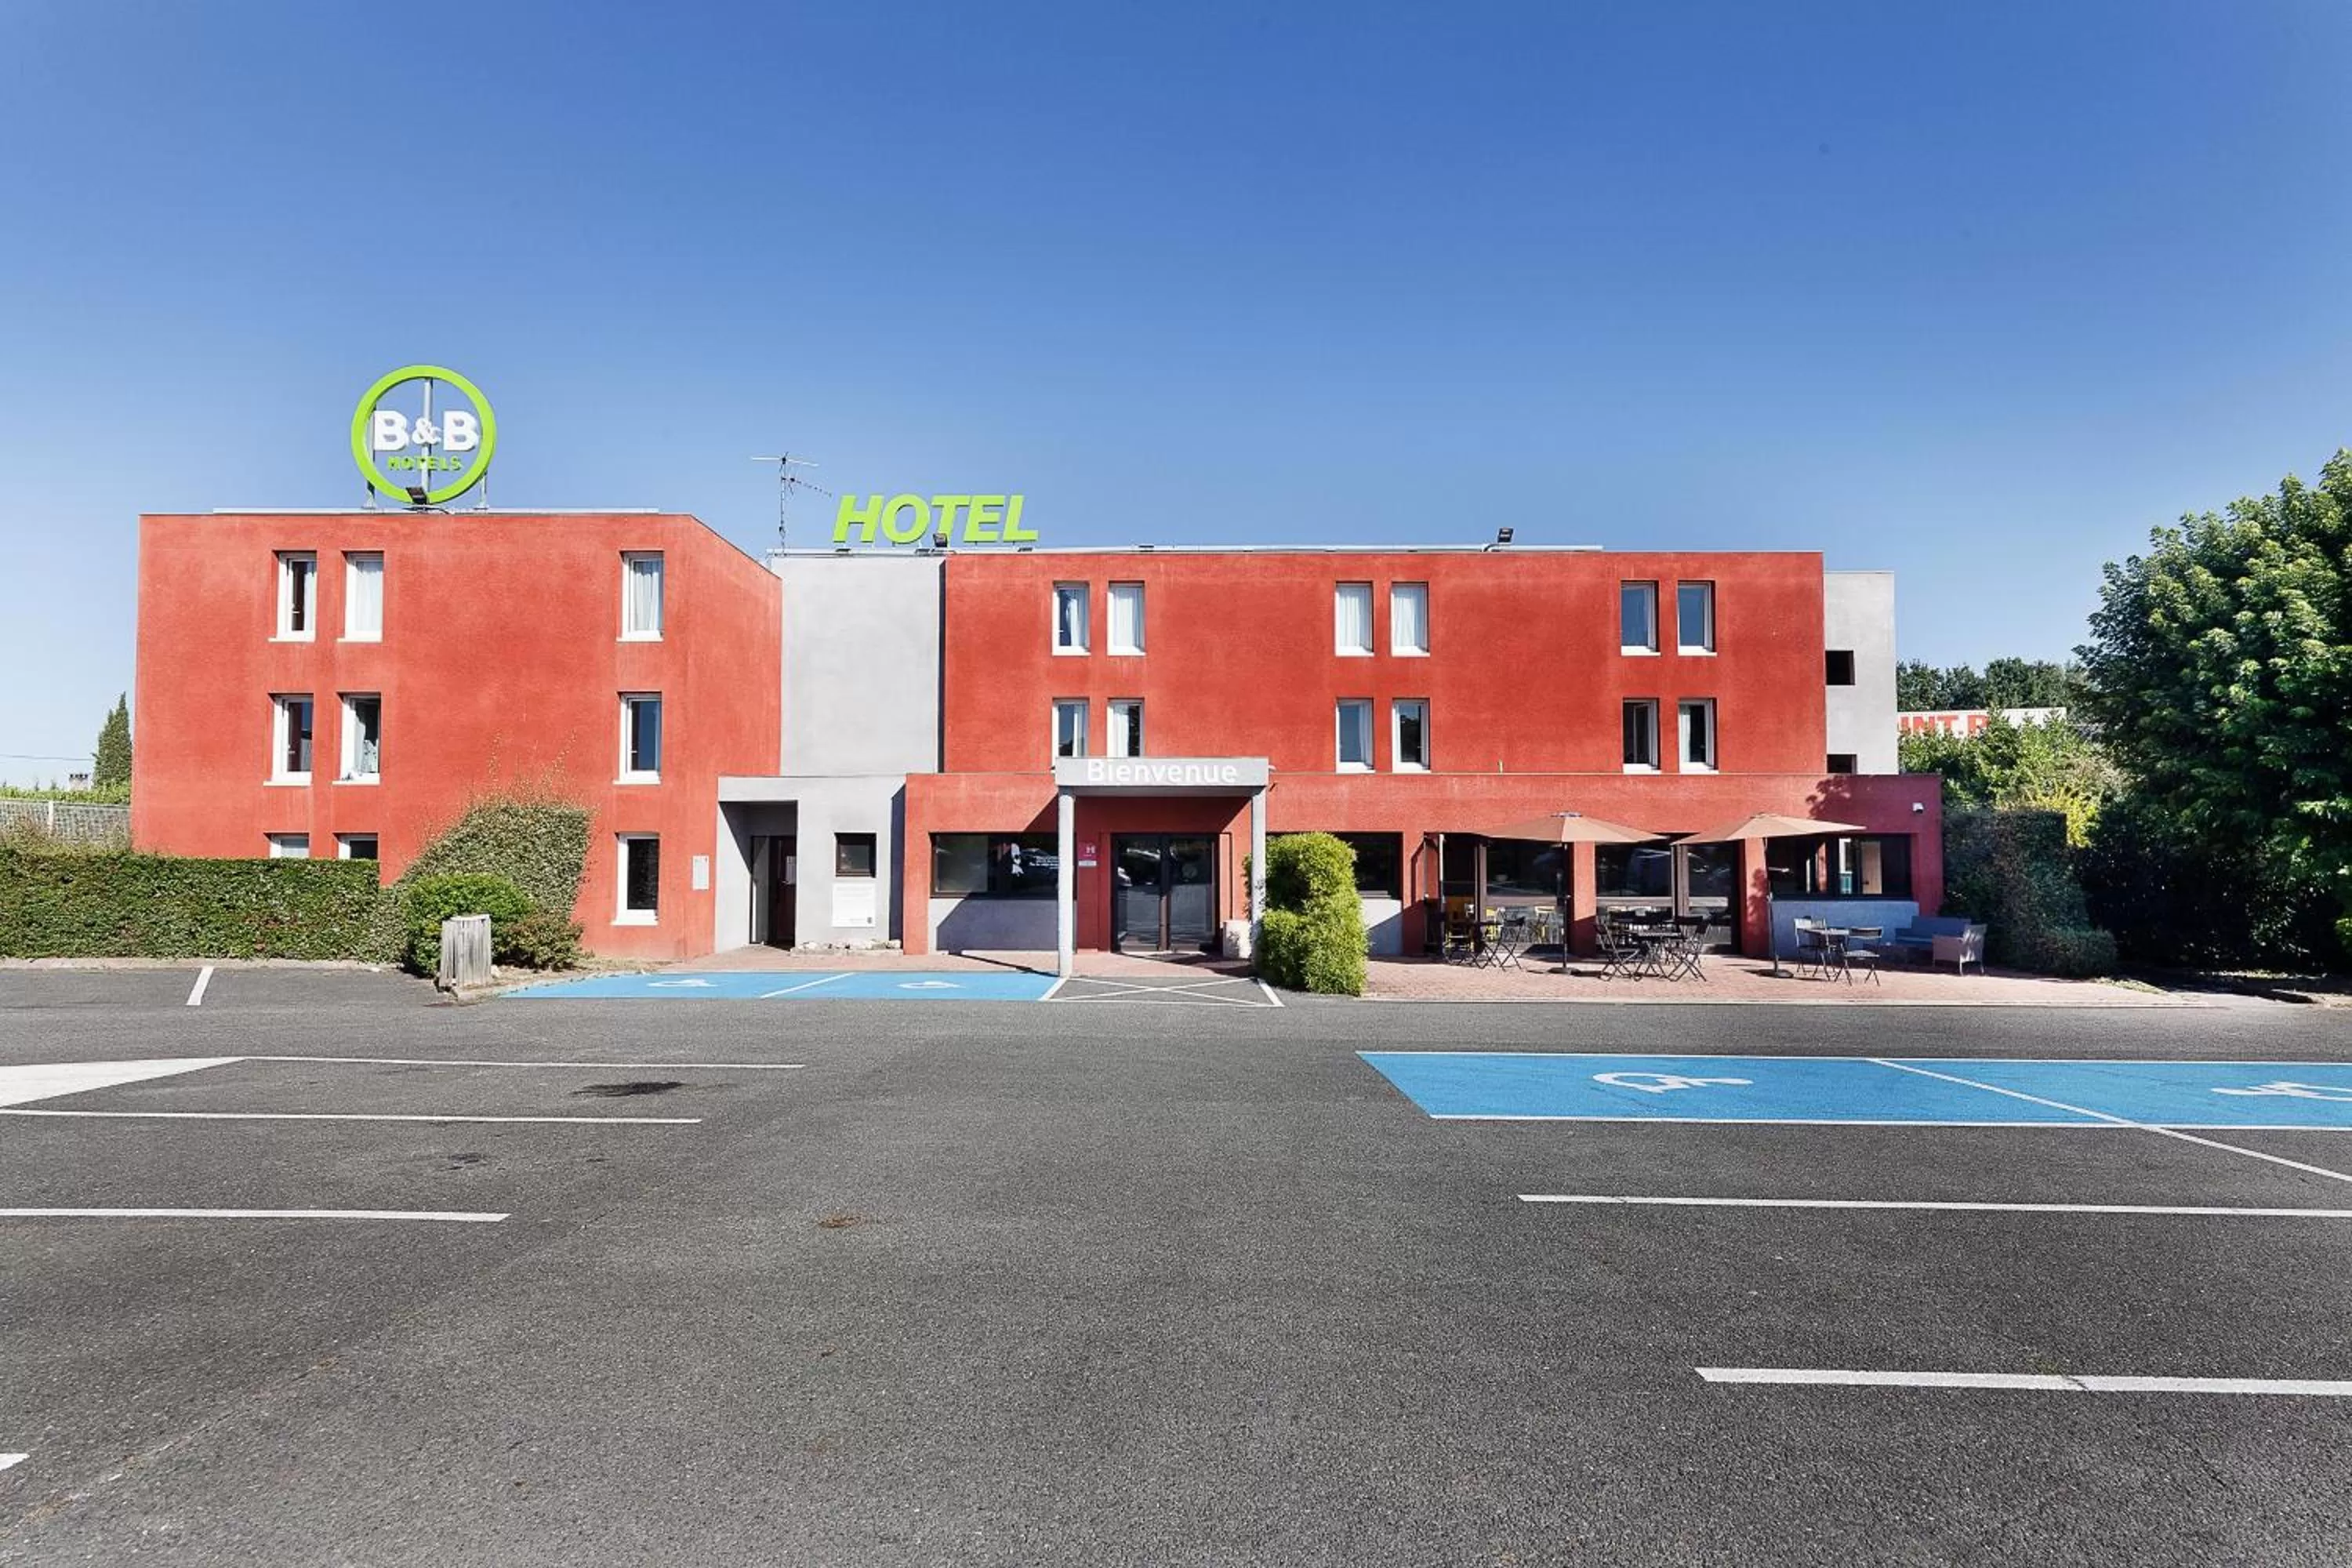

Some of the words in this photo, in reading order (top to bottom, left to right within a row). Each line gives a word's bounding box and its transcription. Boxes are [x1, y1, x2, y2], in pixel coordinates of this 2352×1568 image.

[373, 410, 480, 451] B&B
[387, 456, 463, 470] HOTELS
[833, 493, 1039, 543] HOTEL
[1087, 757, 1239, 783] Bienvenue
